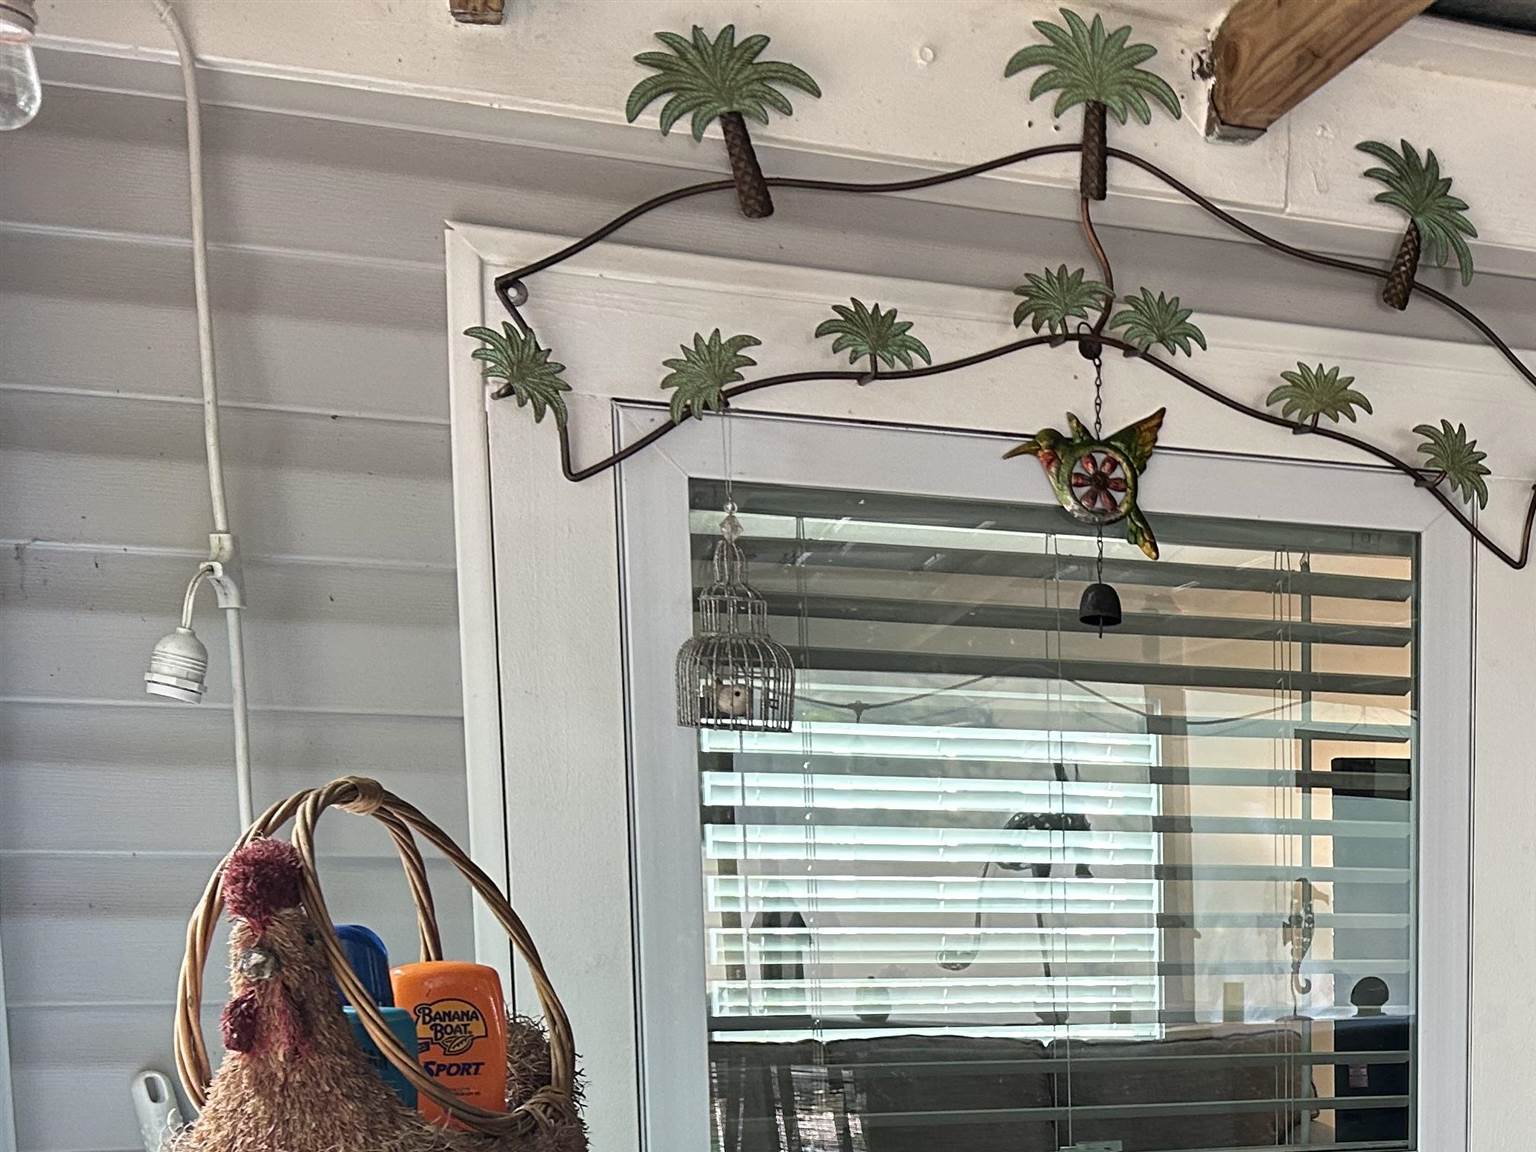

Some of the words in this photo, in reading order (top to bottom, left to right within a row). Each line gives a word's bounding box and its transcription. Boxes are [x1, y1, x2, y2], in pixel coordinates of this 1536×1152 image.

[417, 1006, 479, 1025] BANANA
[429, 1023, 470, 1041] BOAT
[422, 1060, 485, 1077] SPORT
